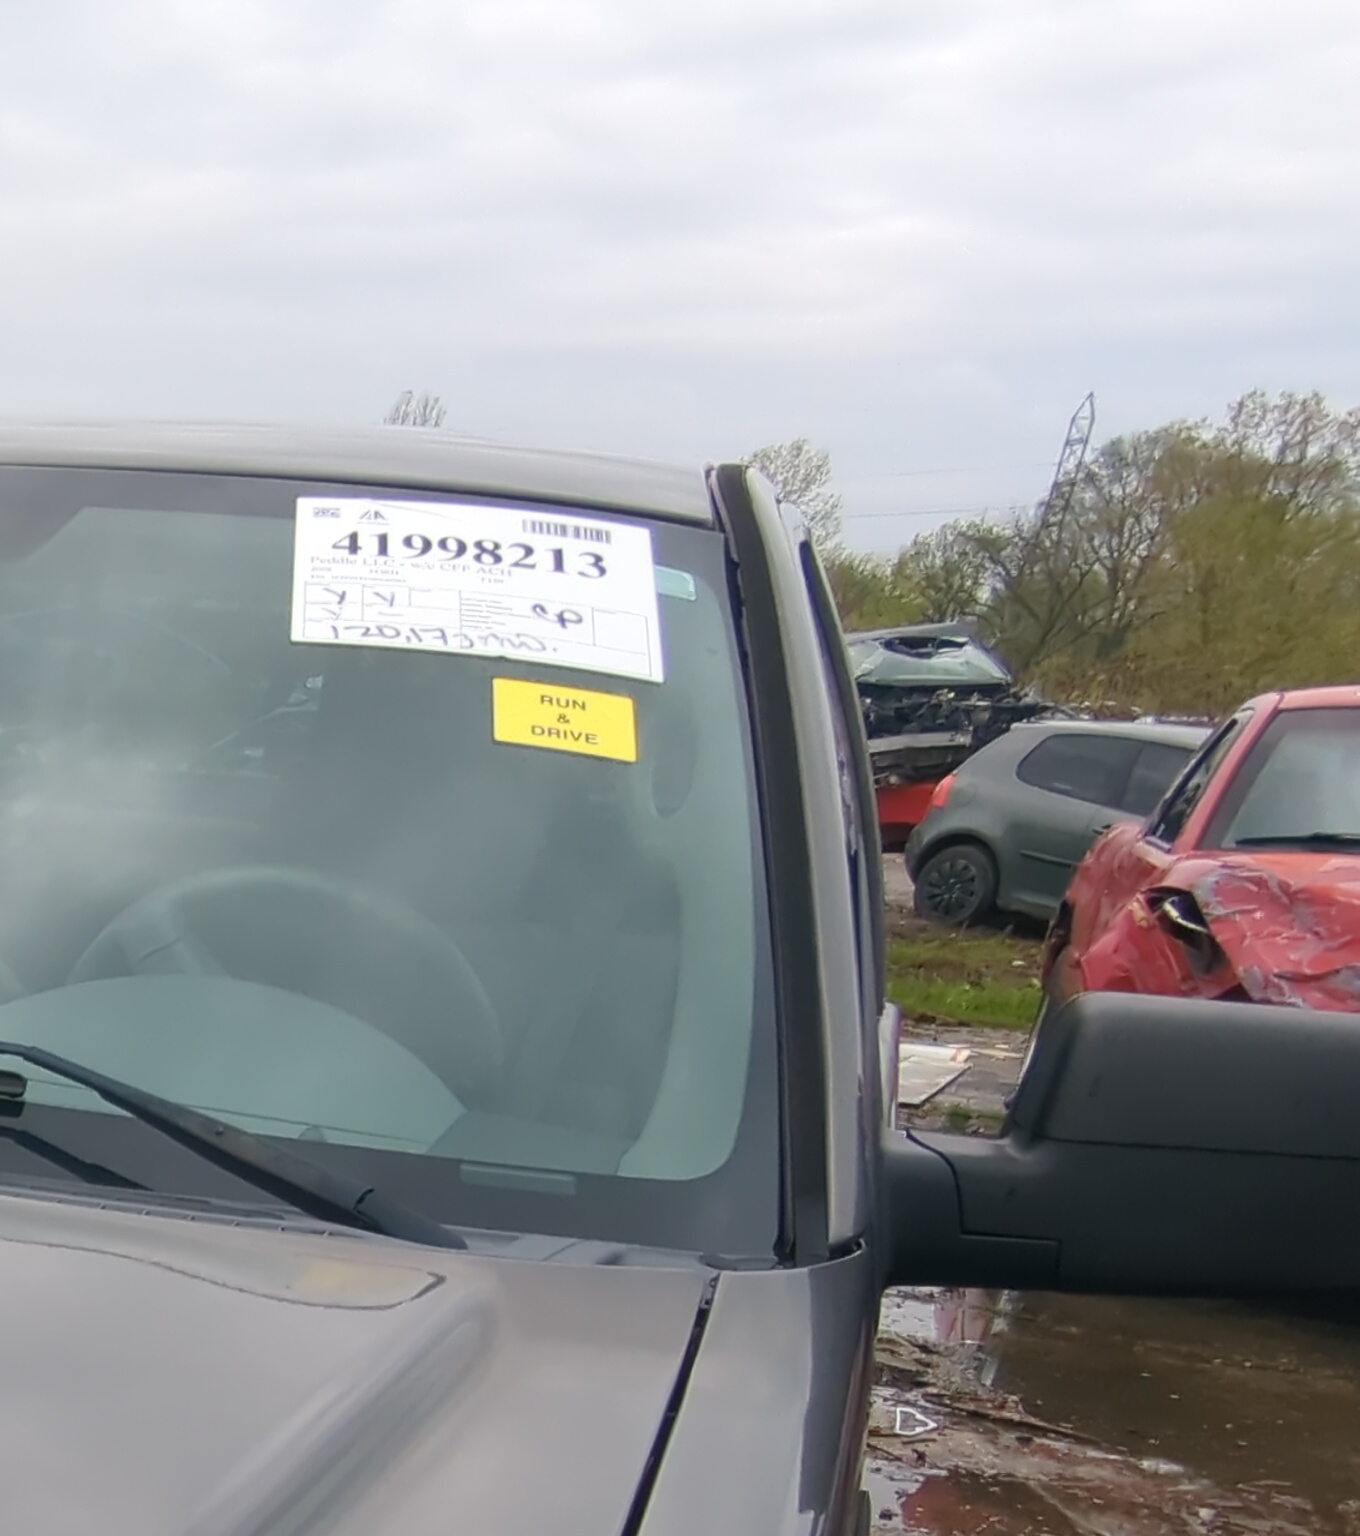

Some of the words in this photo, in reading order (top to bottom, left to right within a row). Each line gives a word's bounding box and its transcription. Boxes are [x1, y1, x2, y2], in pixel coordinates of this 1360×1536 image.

[331, 530, 607, 579] 41998213
[540, 694, 587, 711] RUN
[556, 713, 571, 724] &
[531, 725, 599, 745] DRIVE
